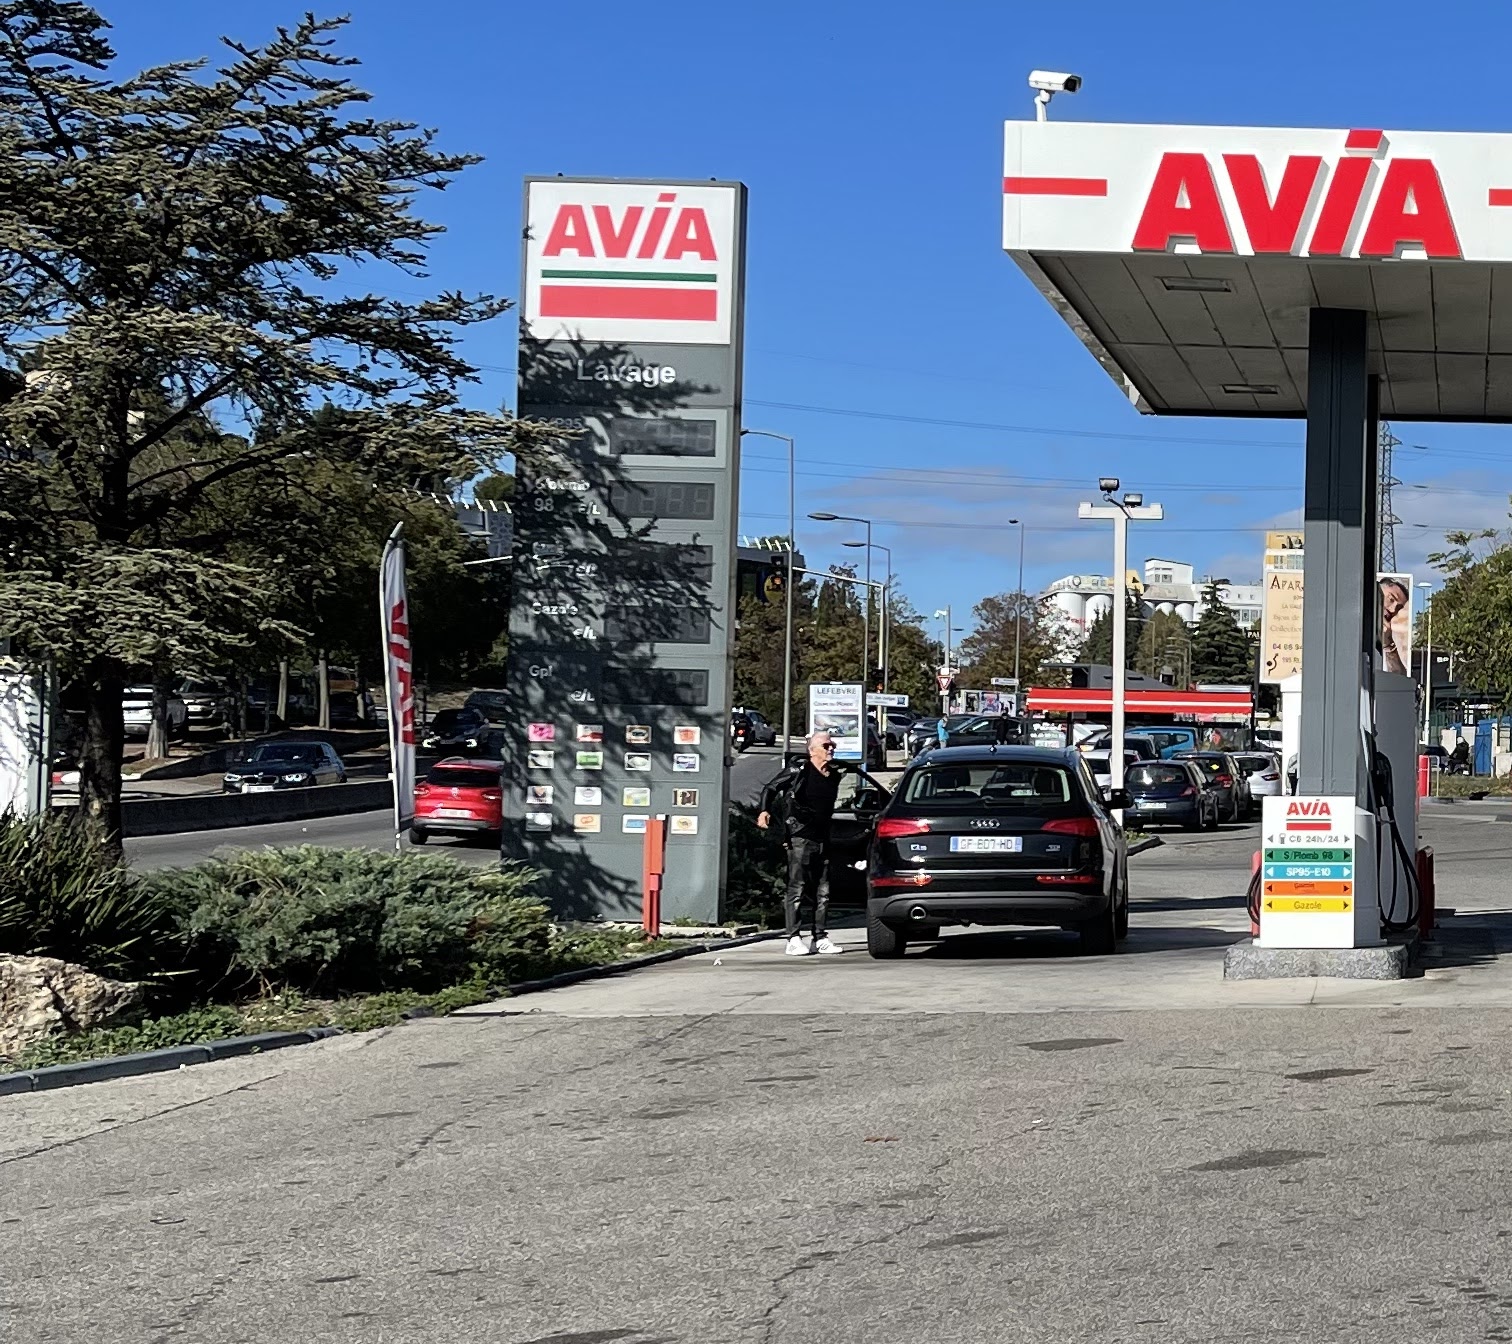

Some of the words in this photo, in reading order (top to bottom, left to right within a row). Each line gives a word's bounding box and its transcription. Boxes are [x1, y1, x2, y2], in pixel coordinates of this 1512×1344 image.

[577, 360, 676, 387] Lavage
[534, 498, 554, 512] 98
[529, 665, 552, 678] Gpl
[1306, 835, 1339, 843] 24h/24
[1283, 850, 1319, 860] S/Plomb
[1286, 867, 1331, 877] SP95-E10
[1293, 901, 1322, 910] Gazole
